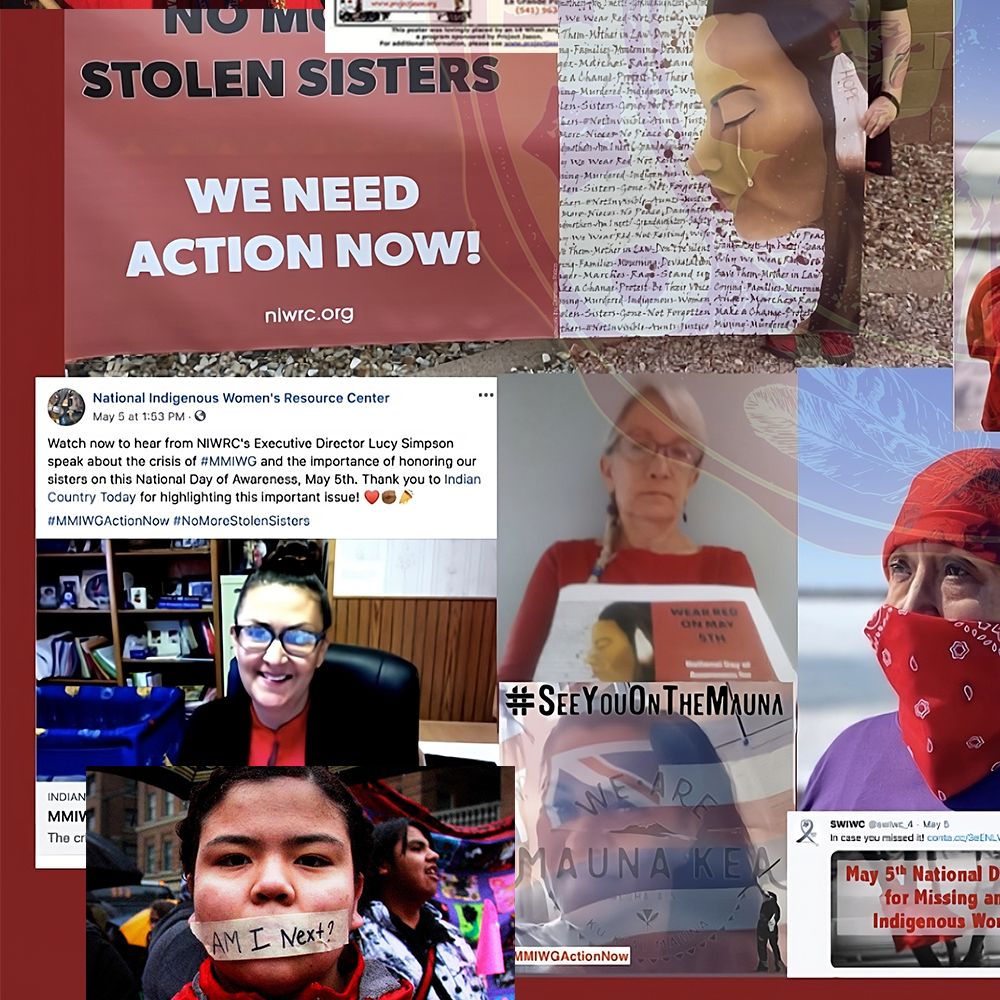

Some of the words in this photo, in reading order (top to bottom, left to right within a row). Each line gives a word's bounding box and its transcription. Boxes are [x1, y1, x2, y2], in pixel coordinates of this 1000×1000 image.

[81, 60, 285, 99] STOLEN
[297, 56, 501, 96] SISTERS
[185, 178, 271, 213] WE
[282, 176, 420, 212] NEED
[126, 234, 324, 278] ACTION
[335, 230, 482, 267] NOW!
[266, 308, 353, 323] niwrc.org
[48, 515, 169, 526] #MMIWGActionNow
[174, 515, 310, 526] #NoMoreStolenSisters
[48, 793, 86, 801] INDIAN
[830, 820, 865, 828] SWIWC
[846, 866, 878, 886] May
[885, 865, 906, 881] 5th
[913, 865, 982, 882] National
[884, 889, 908, 905] for
[922, 889, 978, 909] Missing
[873, 913, 965, 933] Indigenous
[212, 930, 242, 955] AM
[250, 927, 270, 951] I
